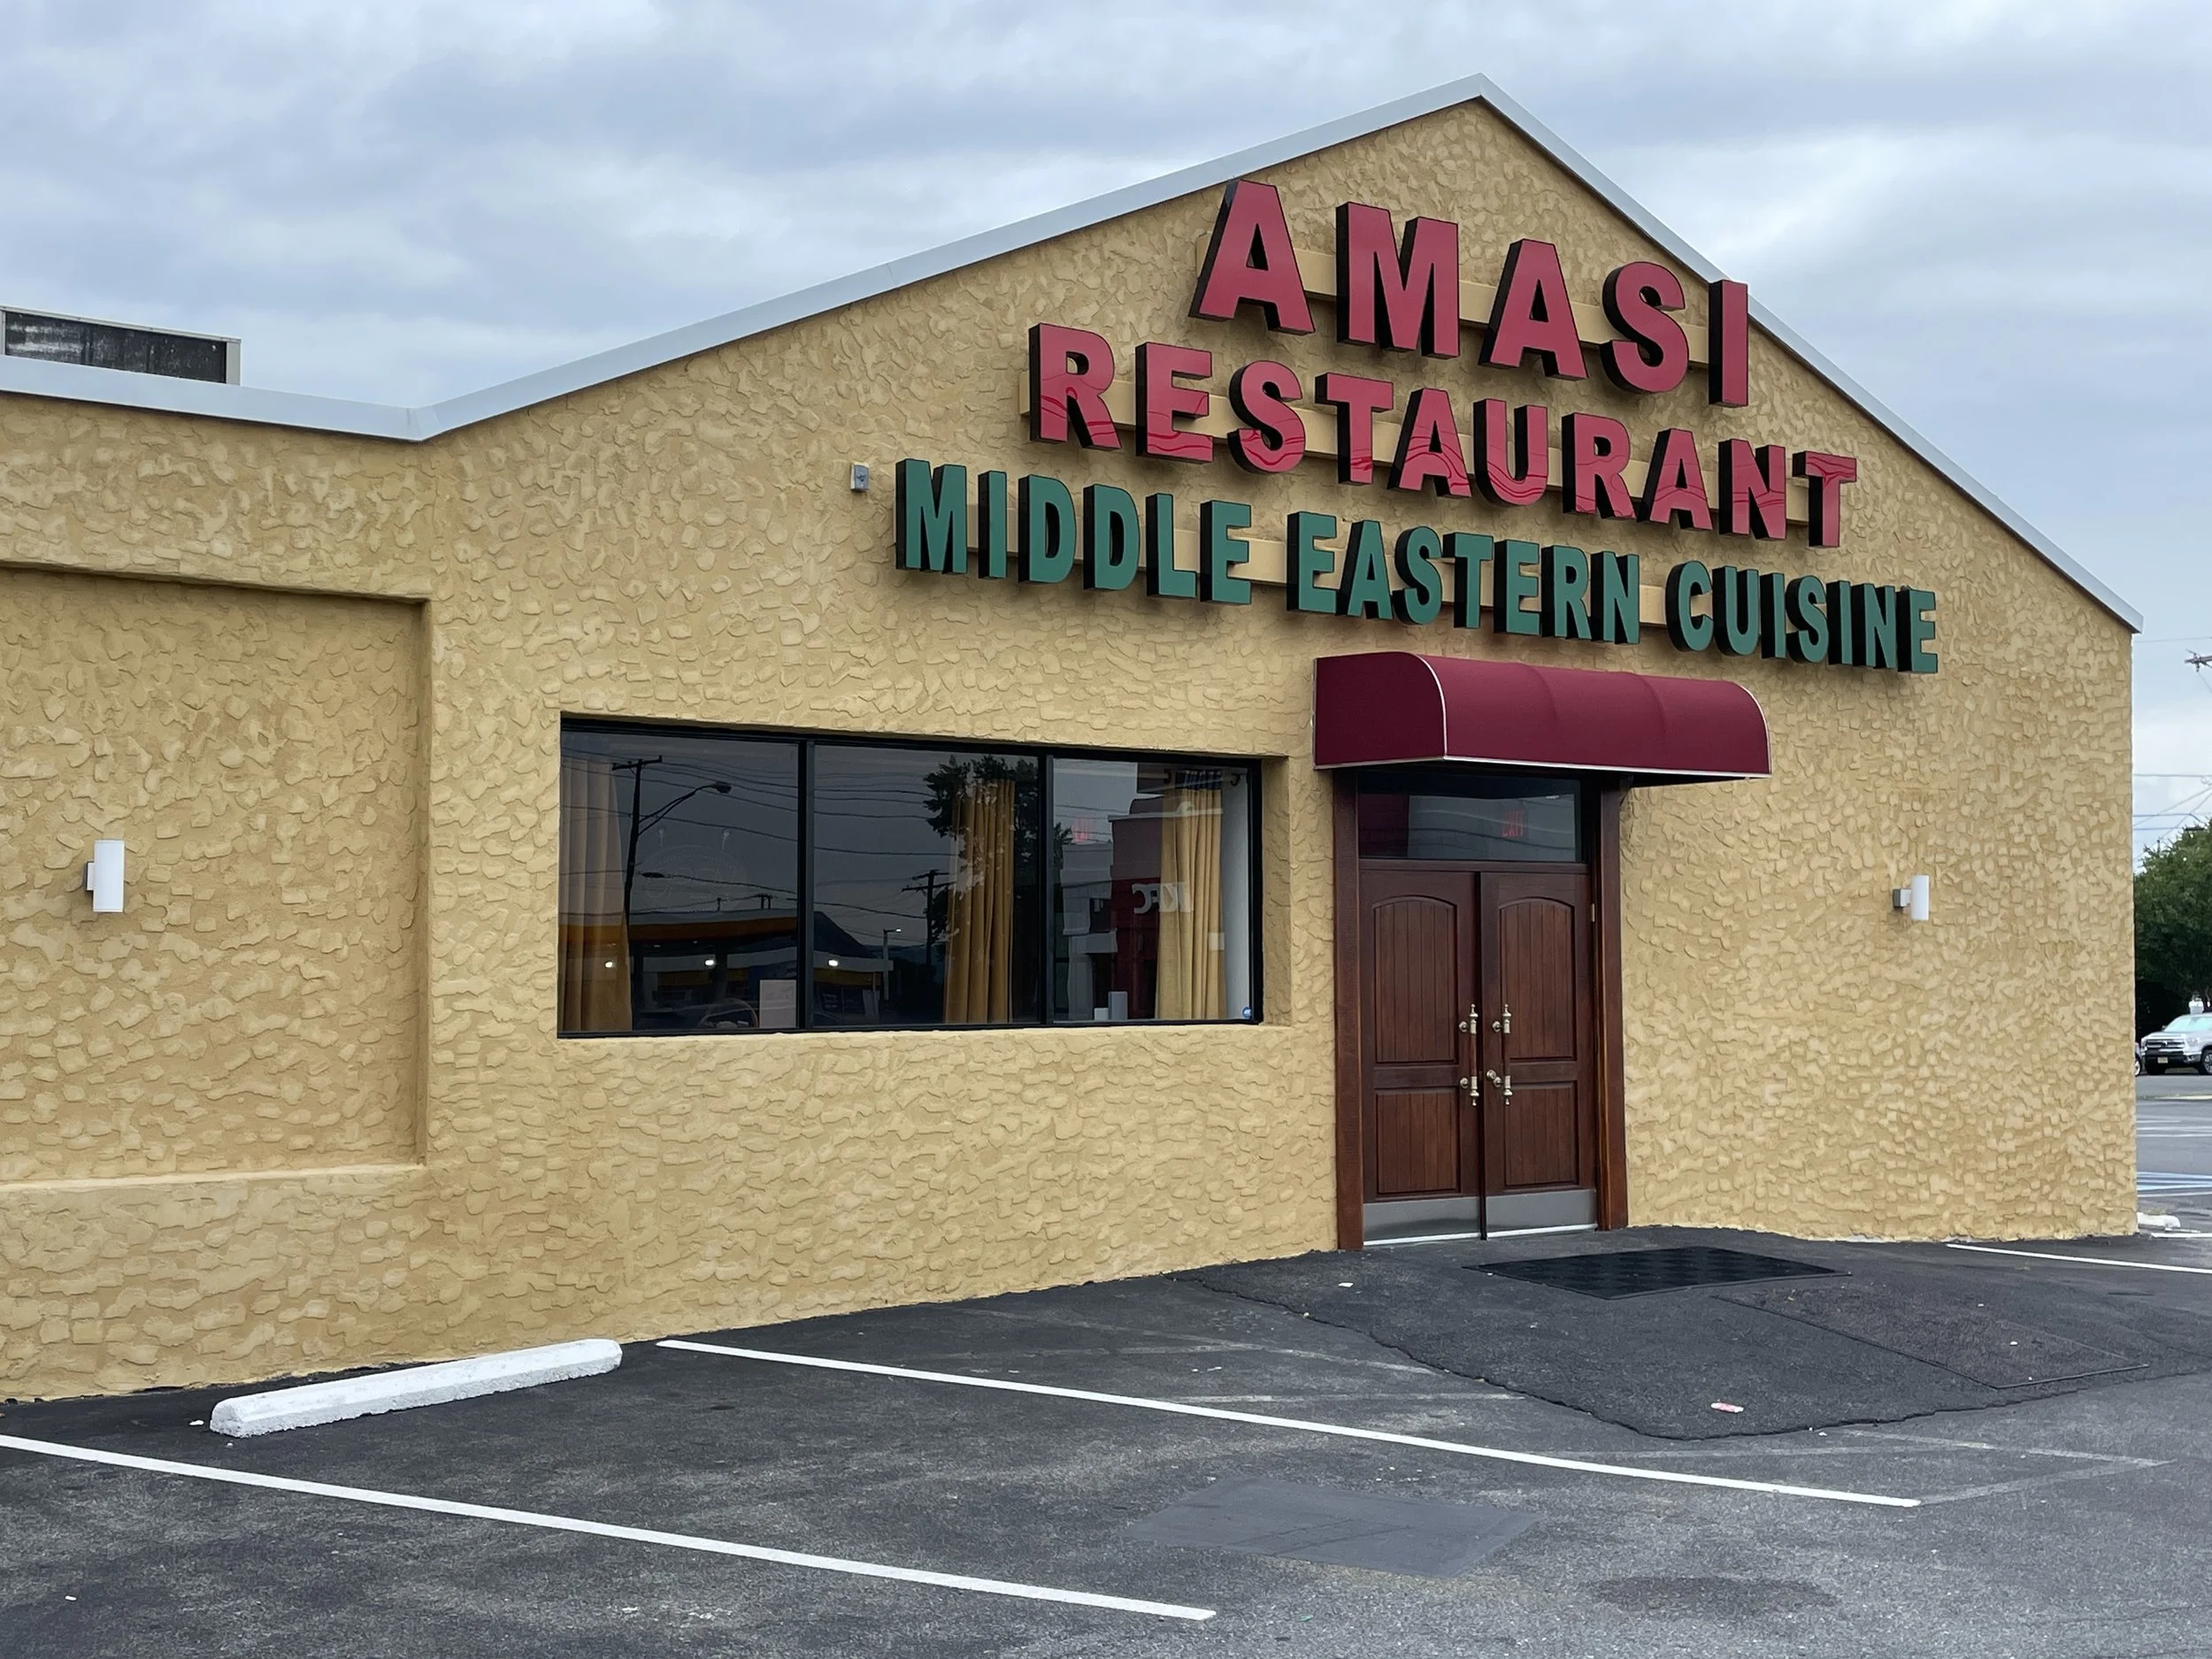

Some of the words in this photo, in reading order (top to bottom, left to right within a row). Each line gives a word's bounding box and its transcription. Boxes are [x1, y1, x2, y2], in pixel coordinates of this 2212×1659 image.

[1191, 180, 1748, 407] AMASI
[1029, 323, 1857, 548] RESTAURANT
[896, 458, 1251, 605] MIDDLE
[1288, 511, 1640, 645] EASTERN
[1667, 561, 1938, 673] CUISINE
